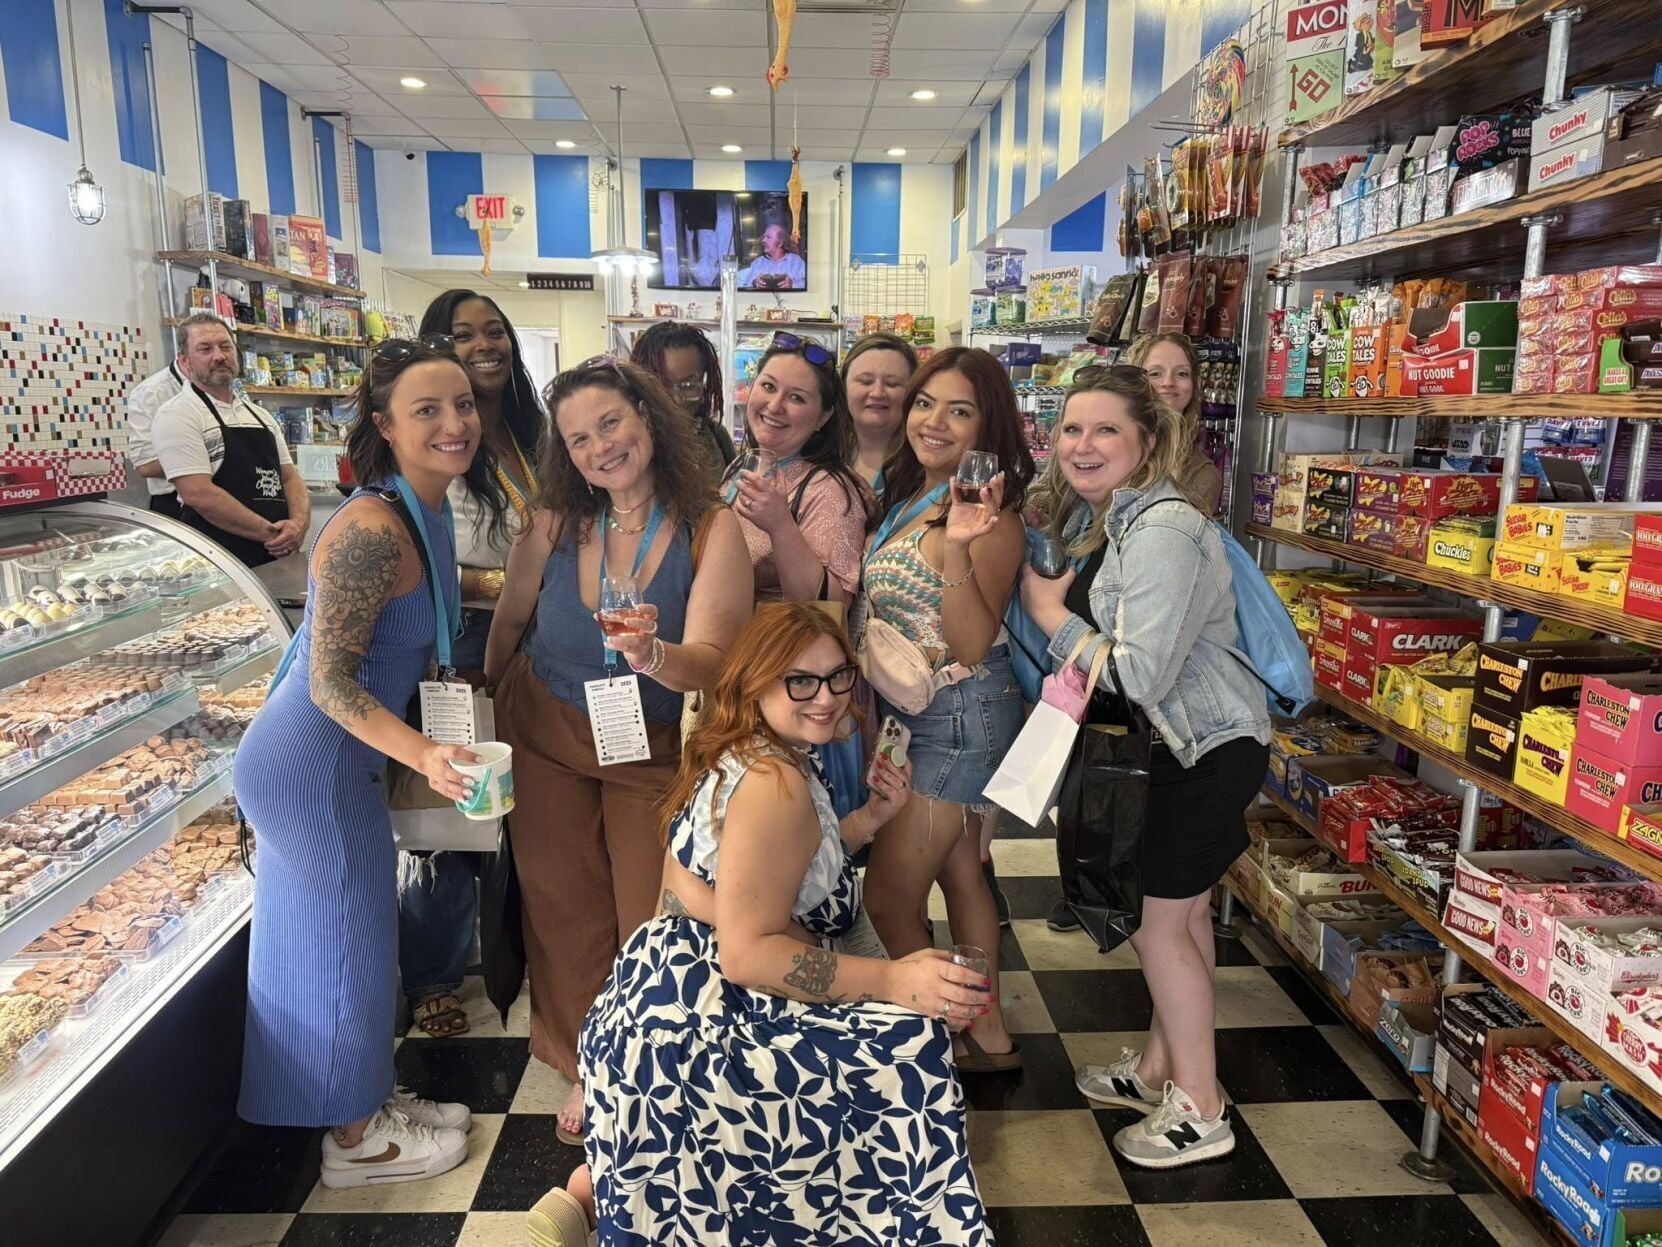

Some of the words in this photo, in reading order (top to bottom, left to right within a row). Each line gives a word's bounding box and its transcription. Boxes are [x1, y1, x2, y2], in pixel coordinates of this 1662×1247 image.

[1297, 68, 1331, 103] GO
[1460, 121, 1491, 144] POP
[1549, 111, 1588, 141] Chunky
[1456, 132, 1500, 161] ROCKS
[1539, 153, 1575, 181] Chunky
[475, 197, 505, 219] EXIT
[1610, 289, 1637, 305] Cella's
[1597, 312, 1627, 326] Cella's
[1327, 338, 1345, 351] COW
[1353, 335, 1374, 348] COW
[1352, 348, 1375, 362] TALES
[1408, 369, 1422, 381] NUT
[1423, 367, 1455, 380] GOODIE
[1494, 364, 1511, 373] NUT
[2, 488, 40, 500] Fudge
[1506, 514, 1527, 527] SUGAR
[1508, 521, 1533, 538] BABIES
[1637, 531, 1651, 541] 100
[1434, 541, 1471, 561] Chuckles
[1498, 562, 1522, 576] BABIES
[1562, 576, 1580, 587] SUGAR
[1571, 582, 1590, 593] DADDY
[1630, 580, 1644, 591] 100
[1351, 627, 1370, 643] CLARK
[1391, 633, 1464, 651] CLARK
[1480, 653, 1524, 679] CHARLESTON
[1346, 670, 1367, 686] CLARK
[1498, 673, 1523, 693] CHEW
[1586, 690, 1631, 715] CHARLESTON
[1471, 712, 1510, 737] CHARLESTO
[1605, 709, 1630, 730] CHEW
[1489, 732, 1513, 753] CHEW
[1541, 755, 1565, 778] CHEW
[1595, 778, 1619, 800] CHEW
[1460, 872, 1474, 892] GOOD
[1474, 879, 1491, 898] NEWS
[1451, 909, 1466, 928] GOOD
[1466, 915, 1484, 935] NEWS
[1575, 943, 1586, 955] BIG
[1570, 987, 1581, 998] BIG
[1623, 1031, 1644, 1052] CHERRY
[1623, 1043, 1644, 1062] MASH
[1490, 1078, 1527, 1115] RockyRoad
[1485, 1131, 1521, 1168] RockyRoad
[1555, 1124, 1592, 1160] RockyRoad
[1539, 1160, 1601, 1228] RockyRoad
